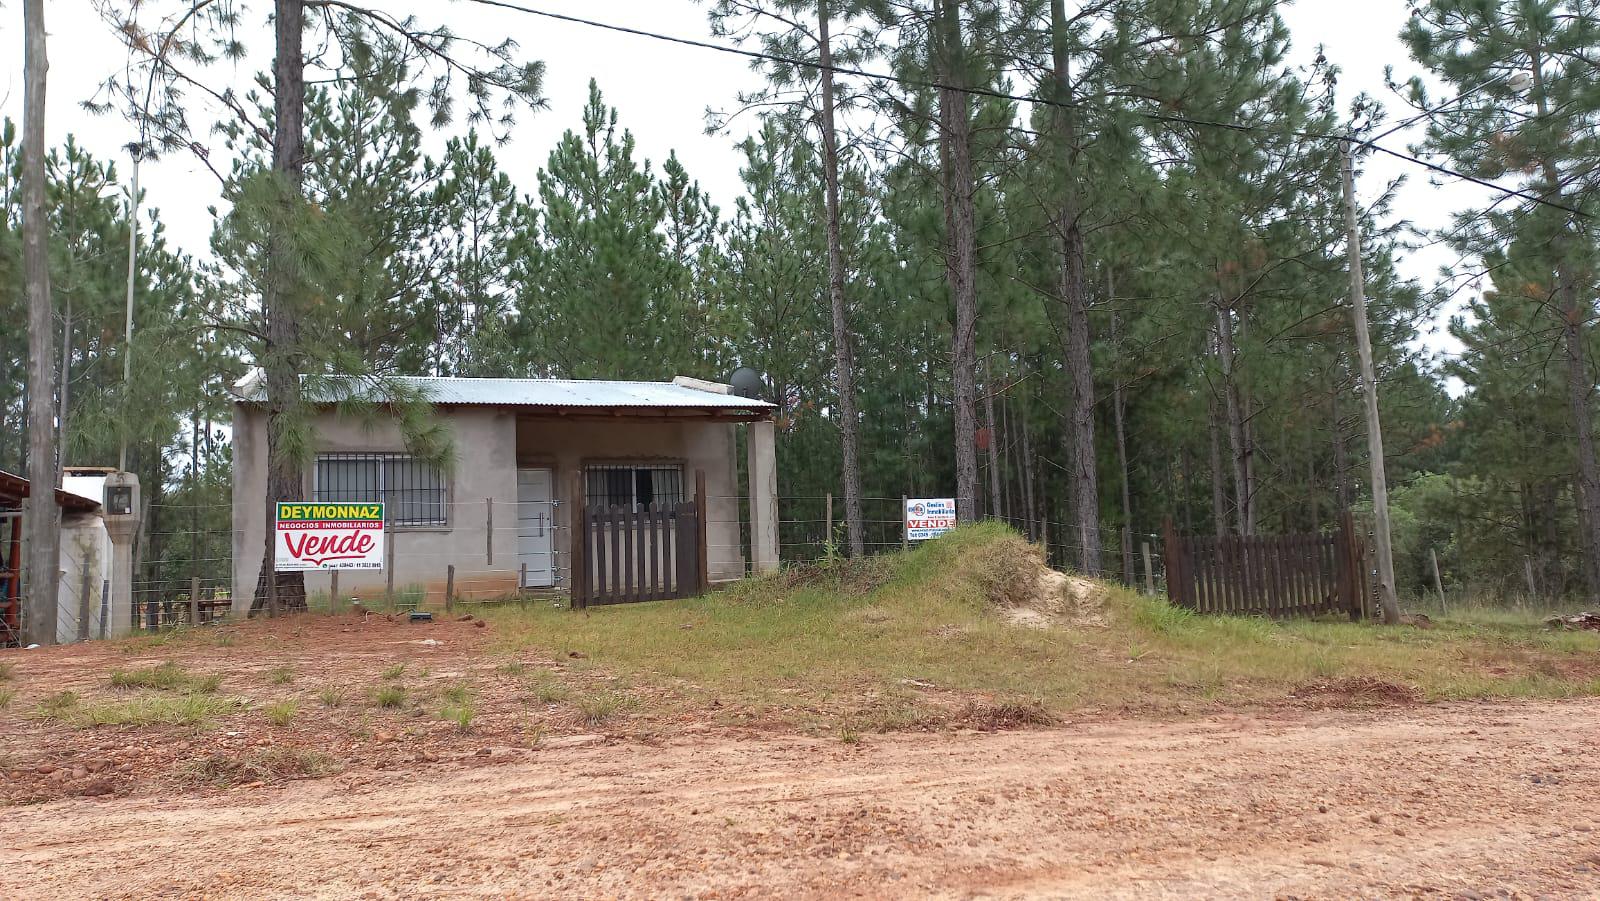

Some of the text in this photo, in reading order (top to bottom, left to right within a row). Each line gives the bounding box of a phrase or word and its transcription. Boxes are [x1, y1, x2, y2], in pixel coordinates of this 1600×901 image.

[281, 506, 379, 518] DEYMONNAZ
[909, 520, 955, 528] VENDE
[284, 530, 375, 558] Vende
